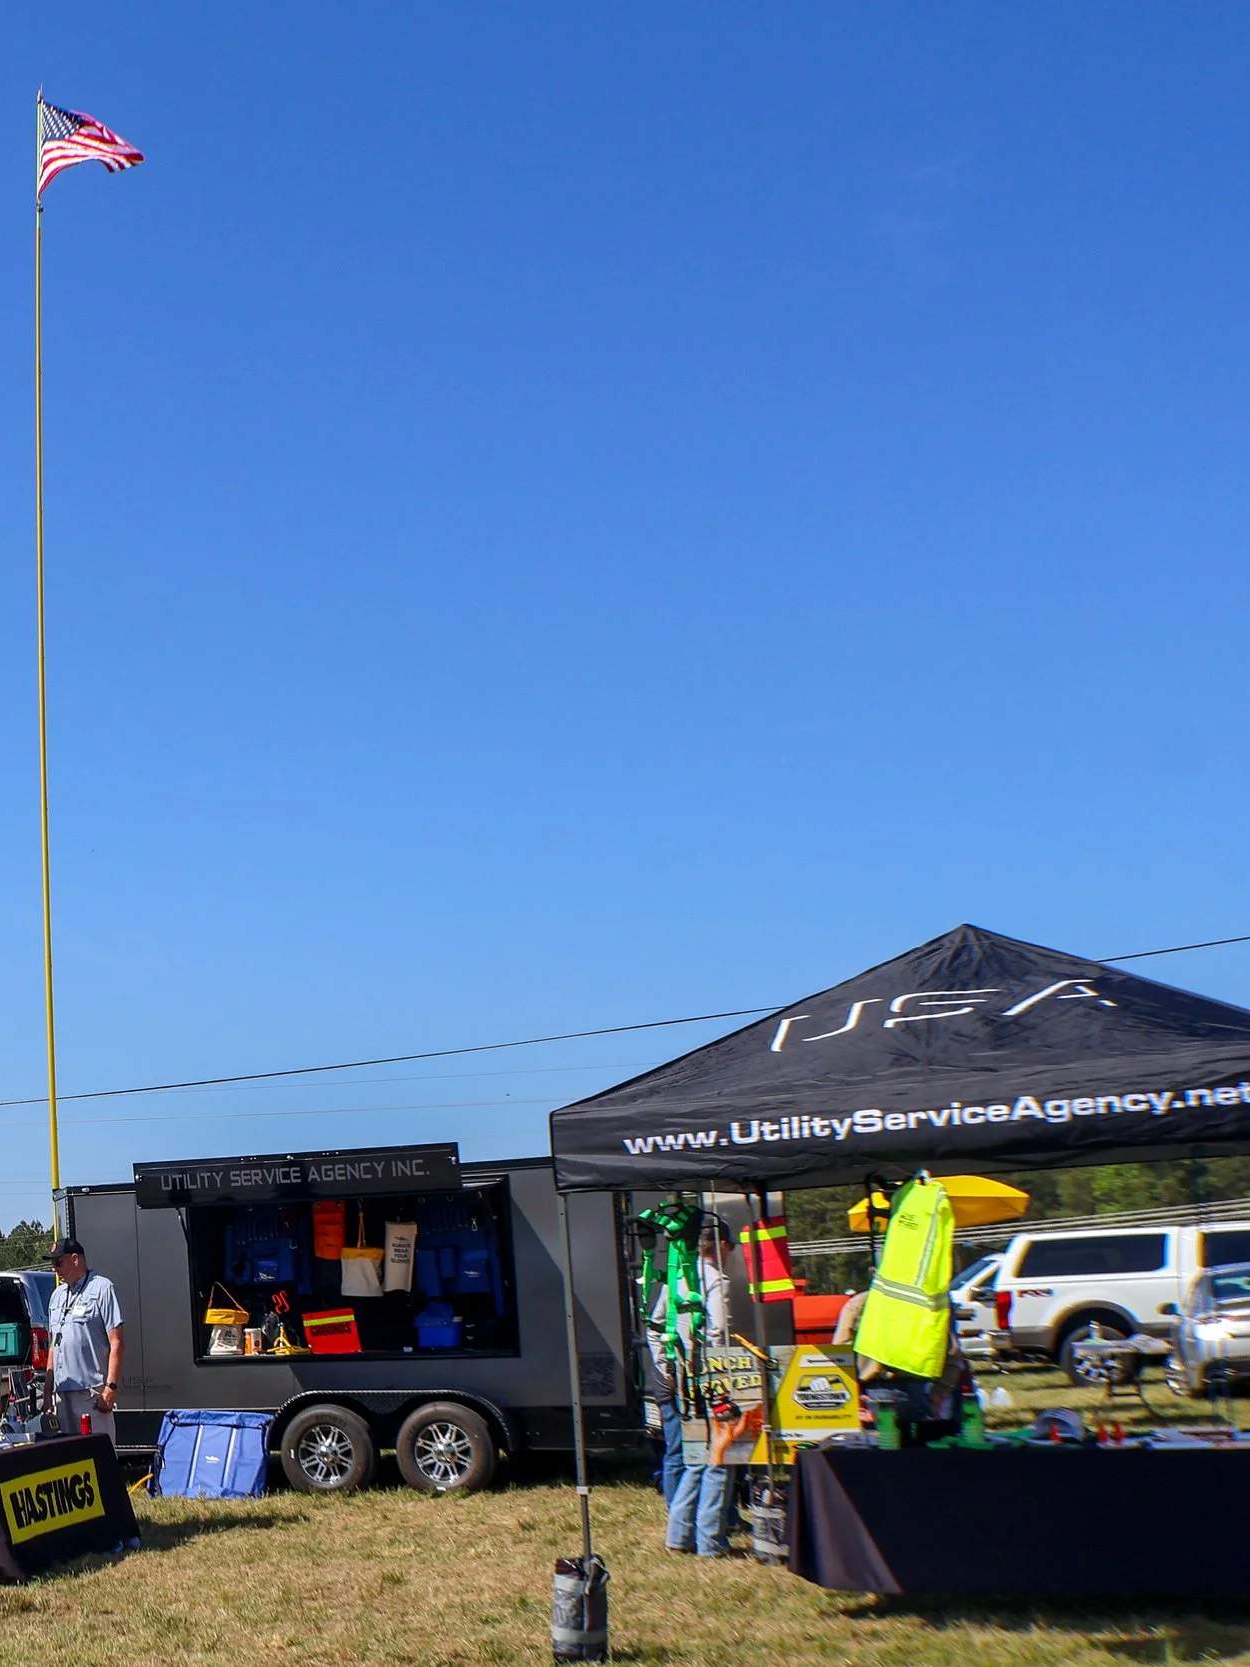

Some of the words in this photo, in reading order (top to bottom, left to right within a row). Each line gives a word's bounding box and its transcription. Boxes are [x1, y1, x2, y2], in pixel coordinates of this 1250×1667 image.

[622, 1081, 1250, 1155] www.UtilityServiceAgency.net
[160, 1171, 223, 1191] UTILITY
[229, 1166, 301, 1187] SERVICE
[307, 1161, 385, 1182] AGENCY
[391, 1158, 431, 1177] INC.
[309, 1321, 352, 1338] GROUNDS
[9, 1471, 95, 1530] HASTINGS
